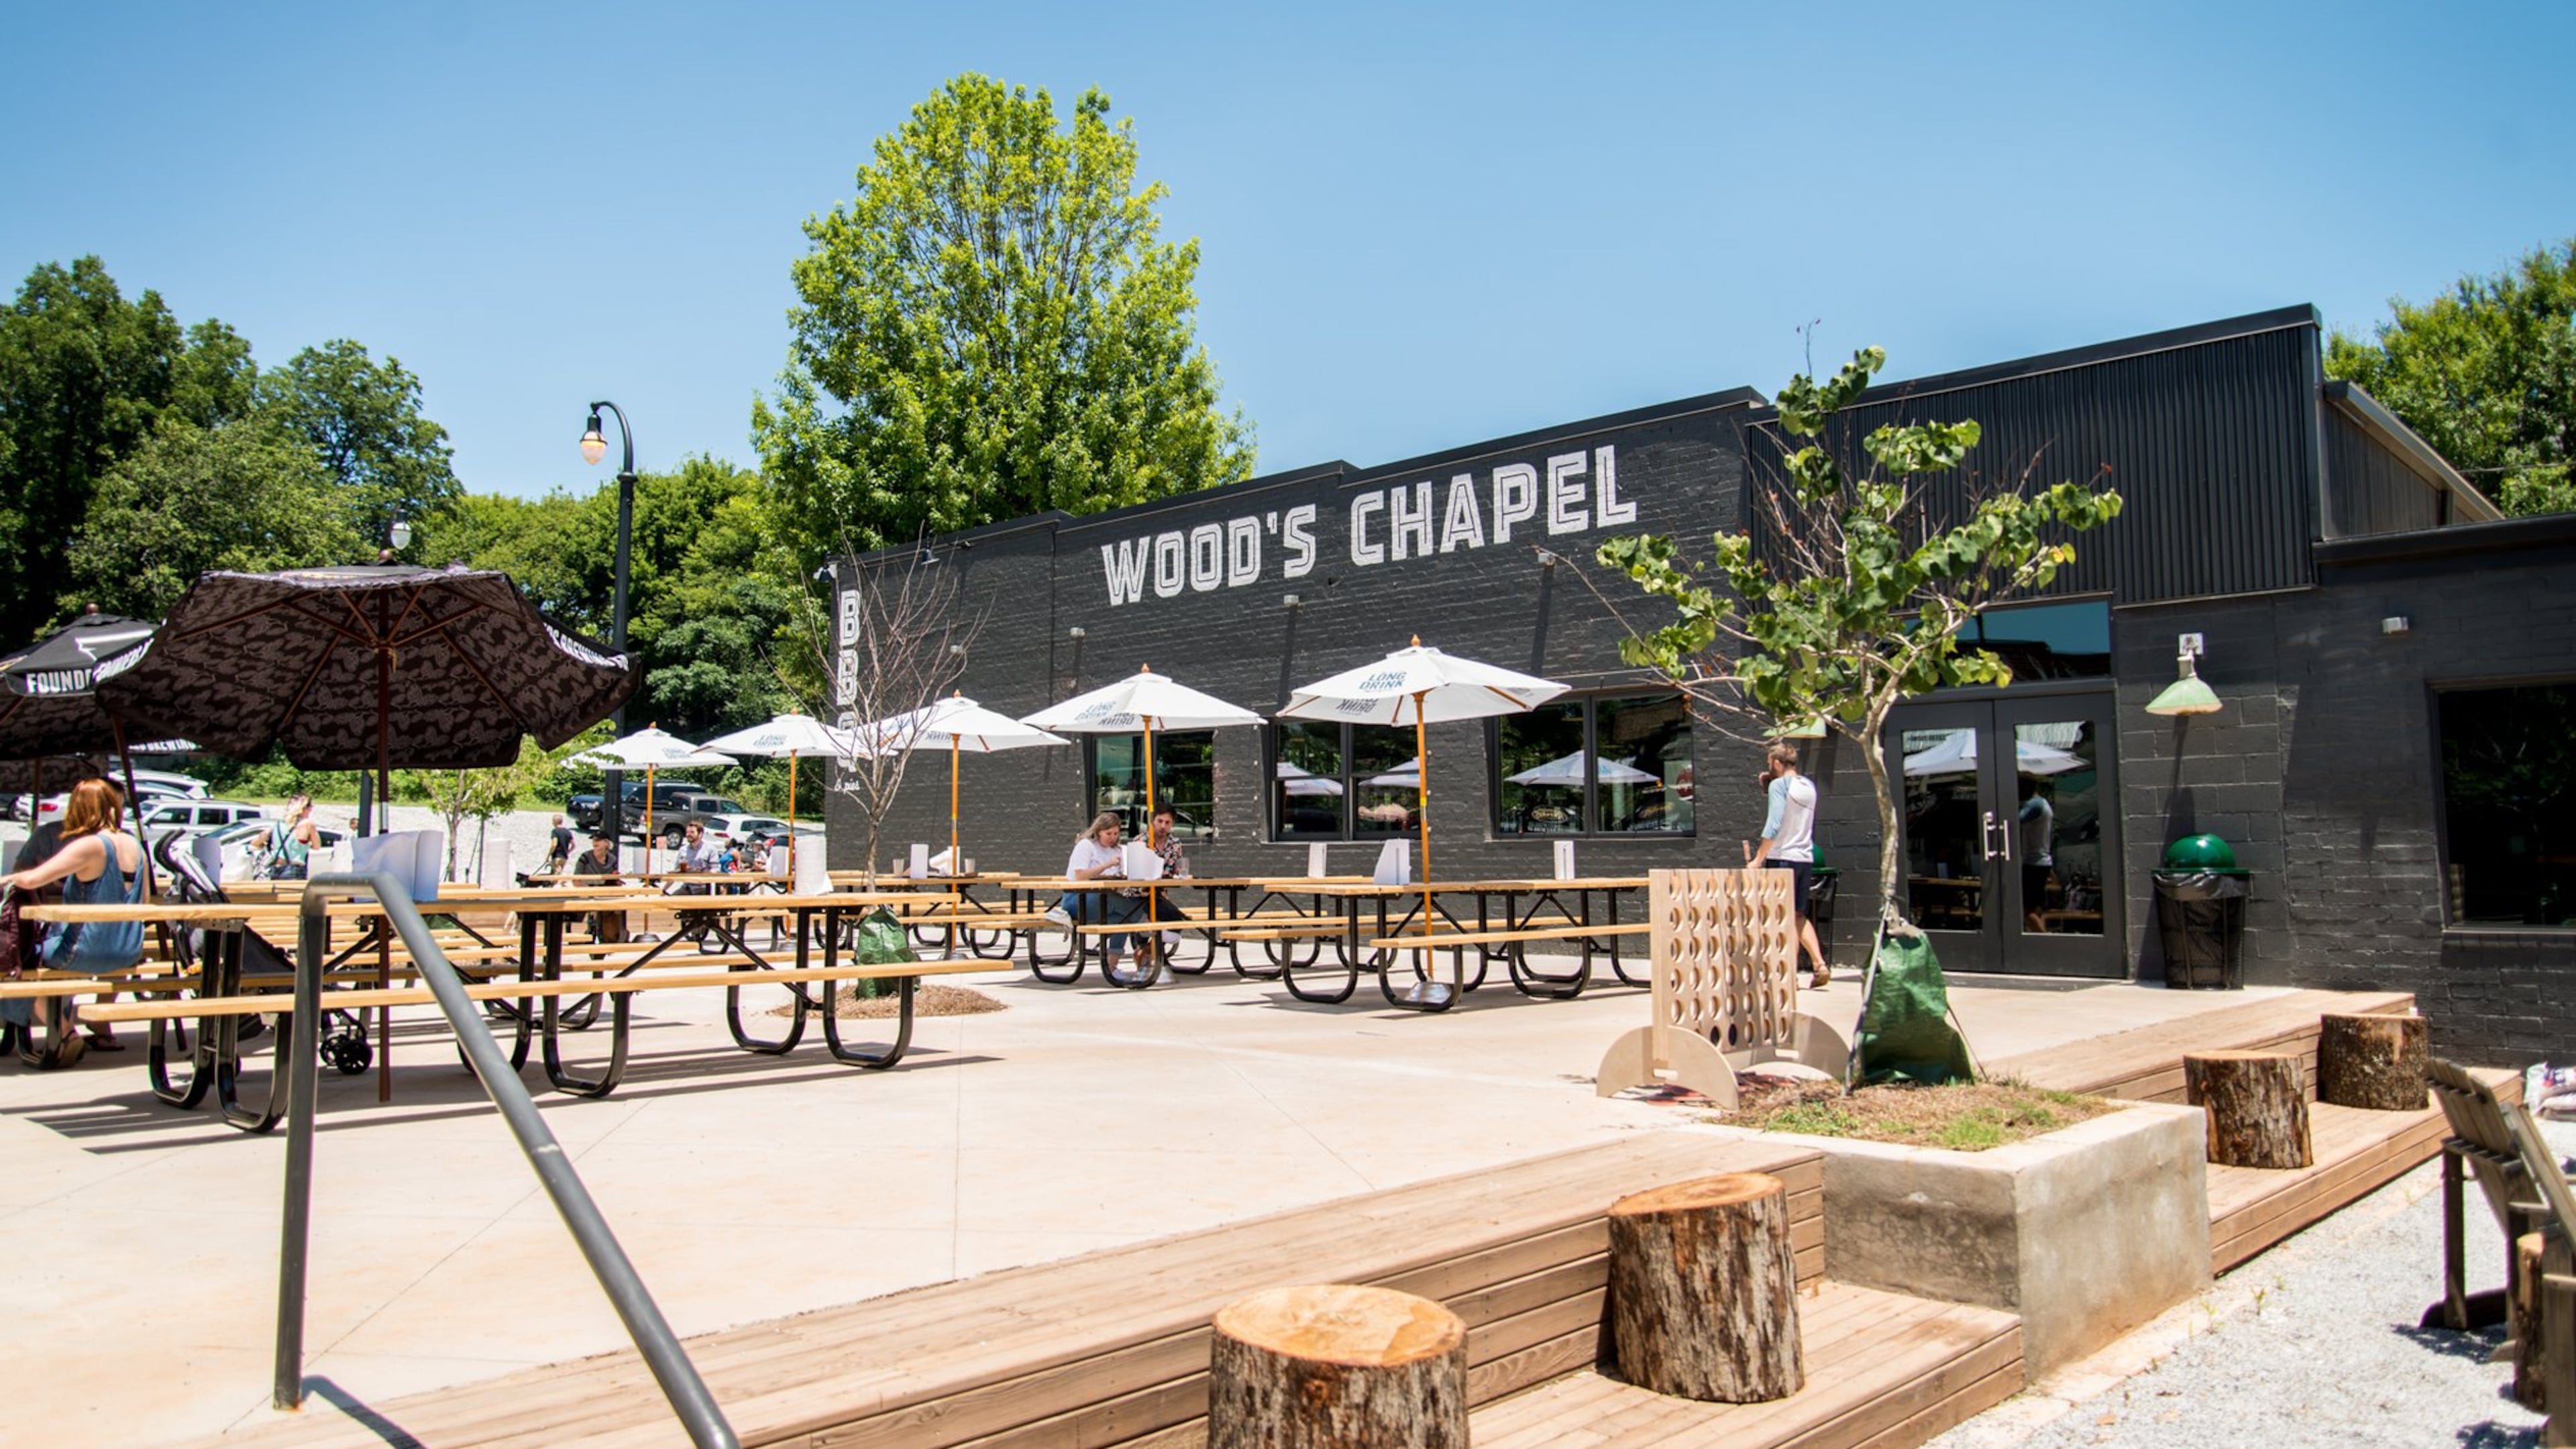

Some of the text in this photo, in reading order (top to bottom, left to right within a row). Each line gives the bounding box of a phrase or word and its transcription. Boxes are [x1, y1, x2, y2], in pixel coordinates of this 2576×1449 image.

[1101, 445, 1638, 606] WOOD'S CHAPEL
[1368, 672, 1407, 681] LONG
[1358, 680, 1403, 690] DRINK
